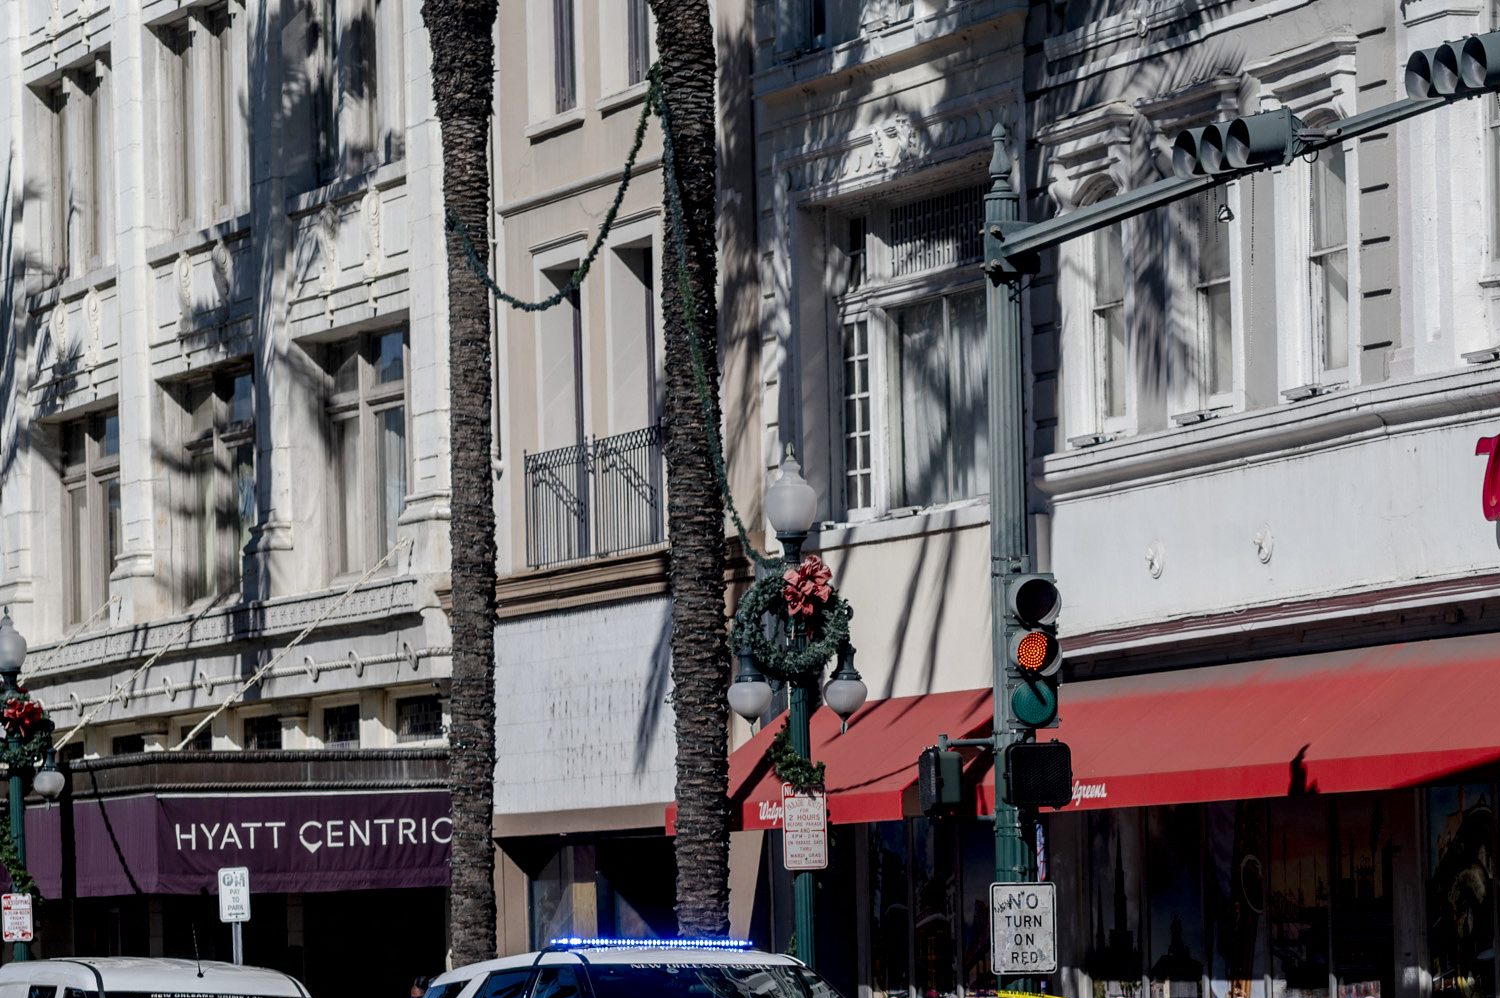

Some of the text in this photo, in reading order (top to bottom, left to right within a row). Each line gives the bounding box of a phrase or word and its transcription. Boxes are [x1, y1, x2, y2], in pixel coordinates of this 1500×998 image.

[175, 817, 453, 854] HYATT CENTRIC
[227, 903, 244, 911] PARK
[1008, 893, 1039, 910] NO
[1005, 915, 1042, 928] TURN
[1014, 934, 1034, 946] ON
[1011, 952, 1038, 964] RED
